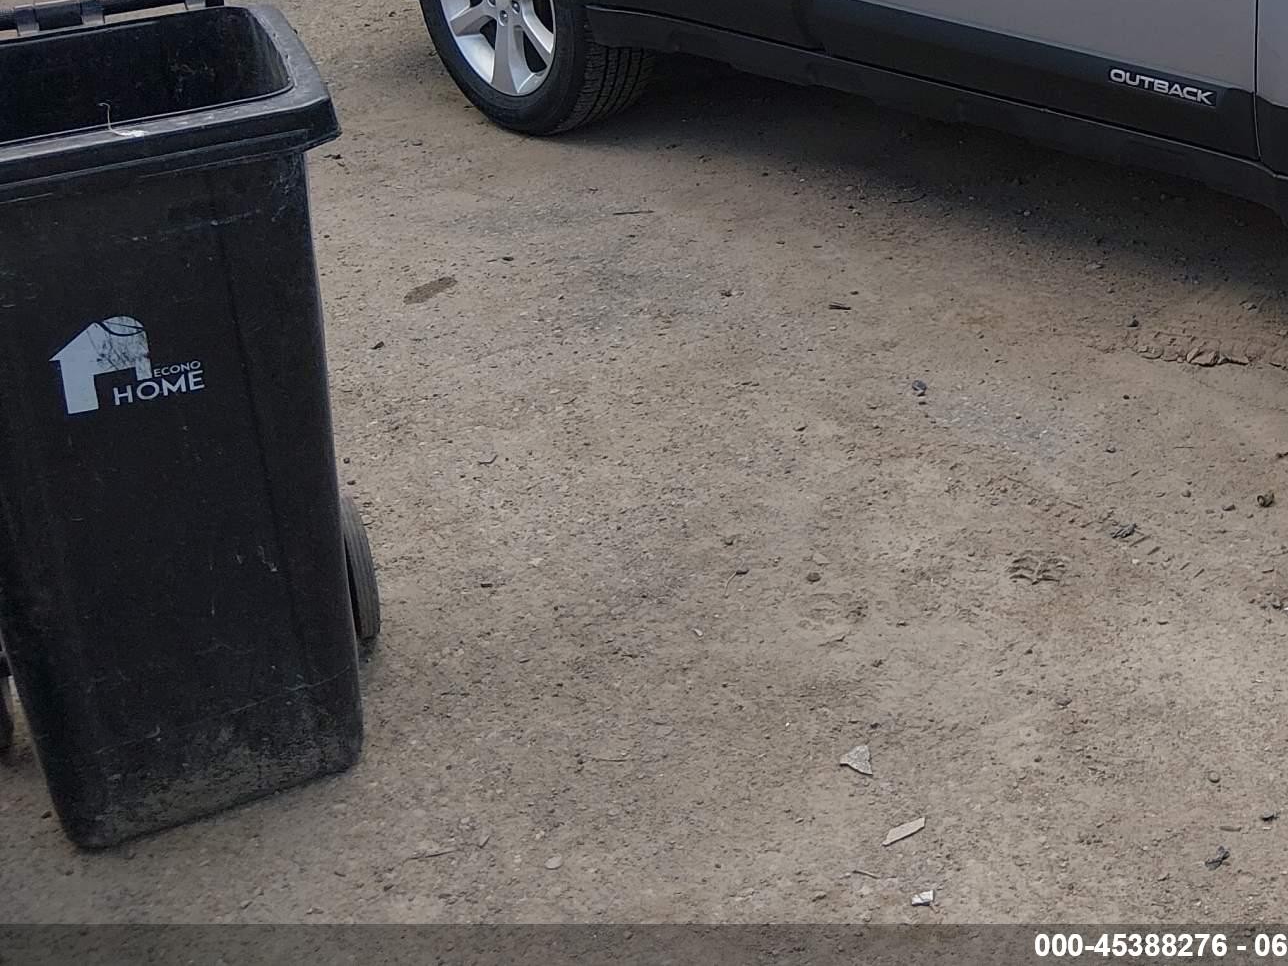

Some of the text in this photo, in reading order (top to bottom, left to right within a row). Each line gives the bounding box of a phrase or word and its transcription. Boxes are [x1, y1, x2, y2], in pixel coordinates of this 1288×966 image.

[1110, 68, 1213, 105] OUTBACK
[153, 360, 201, 378] ECONO
[113, 370, 205, 406] HOME
